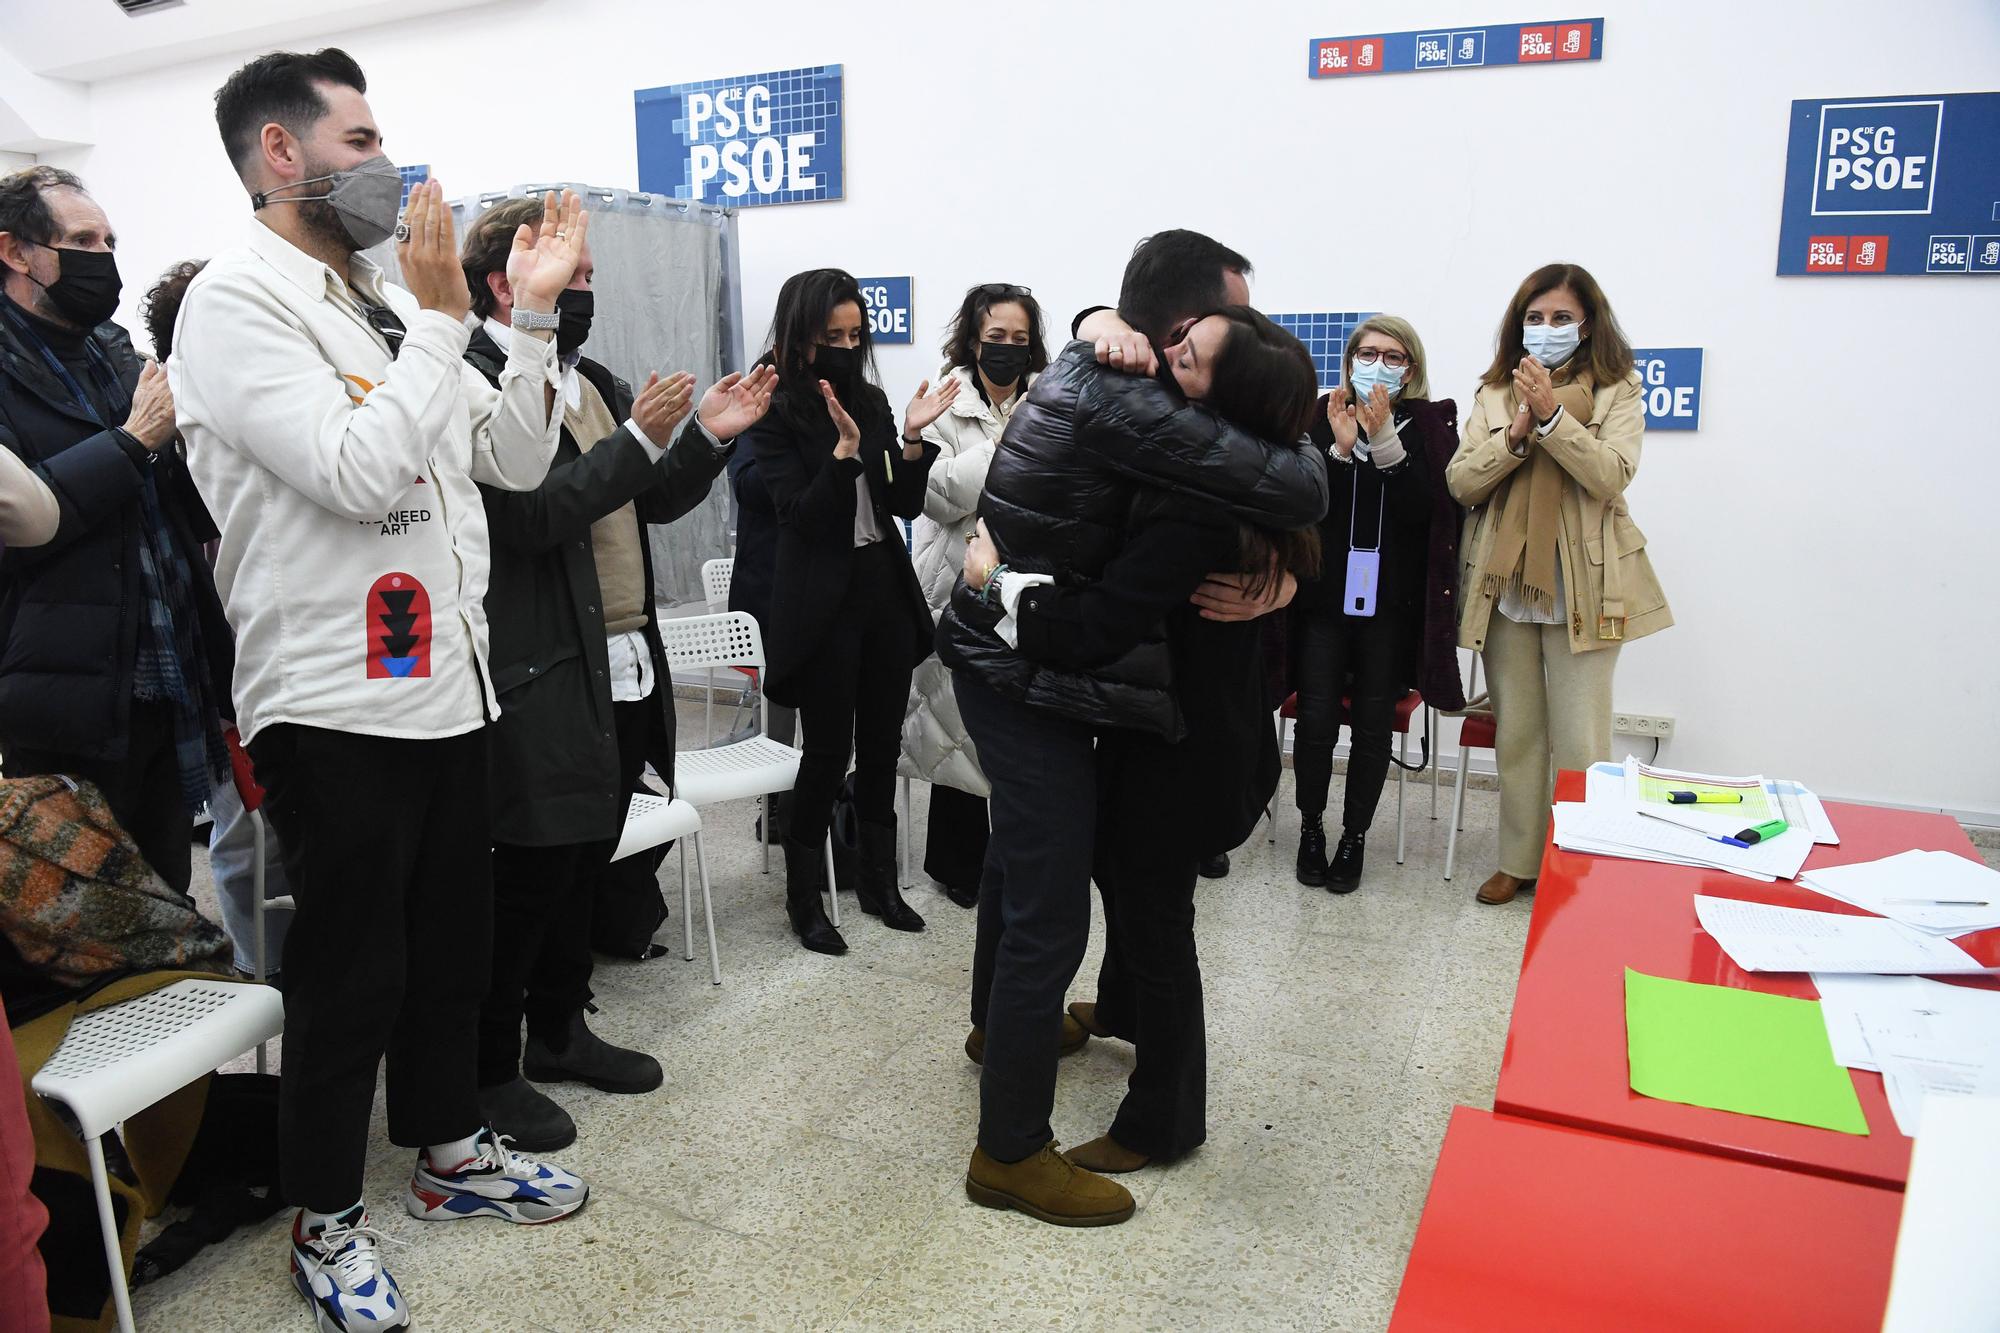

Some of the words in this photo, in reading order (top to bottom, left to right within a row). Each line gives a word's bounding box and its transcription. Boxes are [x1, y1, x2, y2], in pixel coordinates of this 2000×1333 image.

[1522, 33, 1542, 43] PSG
[1420, 41, 1438, 50] PSG
[1520, 42, 1552, 55] PSOE
[1320, 48, 1339, 57] PSG
[1419, 50, 1447, 61] PSOE
[1320, 56, 1348, 68] PSOE
[688, 85, 771, 141] PSG
[1829, 126, 1895, 155] PSG
[690, 133, 816, 200] PSOE
[1825, 156, 1926, 190] PSOE
[1811, 243, 1834, 253] PSG
[1933, 243, 1955, 253] PSG
[1810, 253, 1844, 265] PSOE
[1931, 253, 1965, 264] PSOE
[858, 286, 888, 308] SG
[388, 510, 431, 523] NEED
[381, 523, 409, 536] ART
